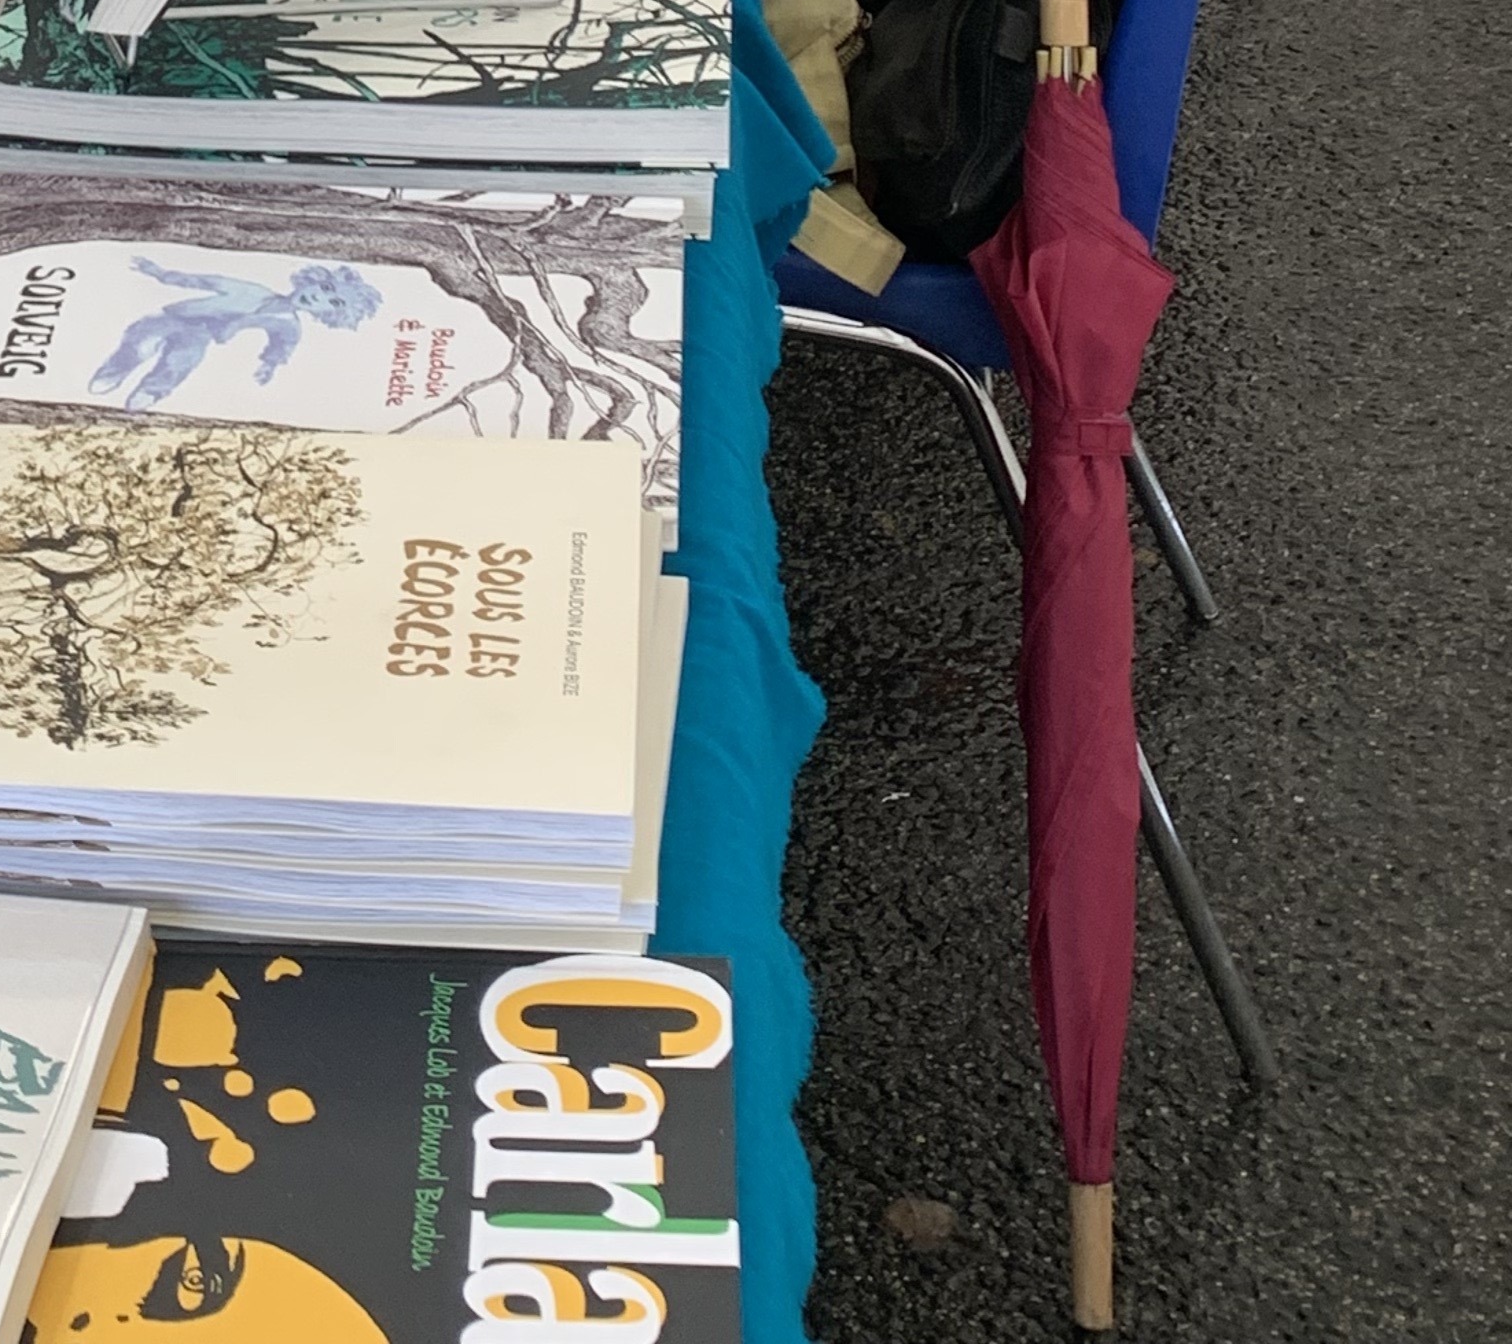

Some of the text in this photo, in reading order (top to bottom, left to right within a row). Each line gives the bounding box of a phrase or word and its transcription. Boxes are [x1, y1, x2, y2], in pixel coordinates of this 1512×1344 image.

[385, 339, 417, 407] Mariette
[424, 328, 456, 399] Baudoin
[569, 531, 588, 577] Edmond
[385, 538, 472, 678] ÉCORCES
[464, 542, 534, 679] SOUS LES
[566, 577, 587, 630] BAUDOIN
[562, 673, 580, 697] BIZE
[564, 639, 583, 673] Aurore
[410, 972, 468, 1273] Jacques Lob et Edmond Baudoin
[459, 953, 742, 1344] Carla
